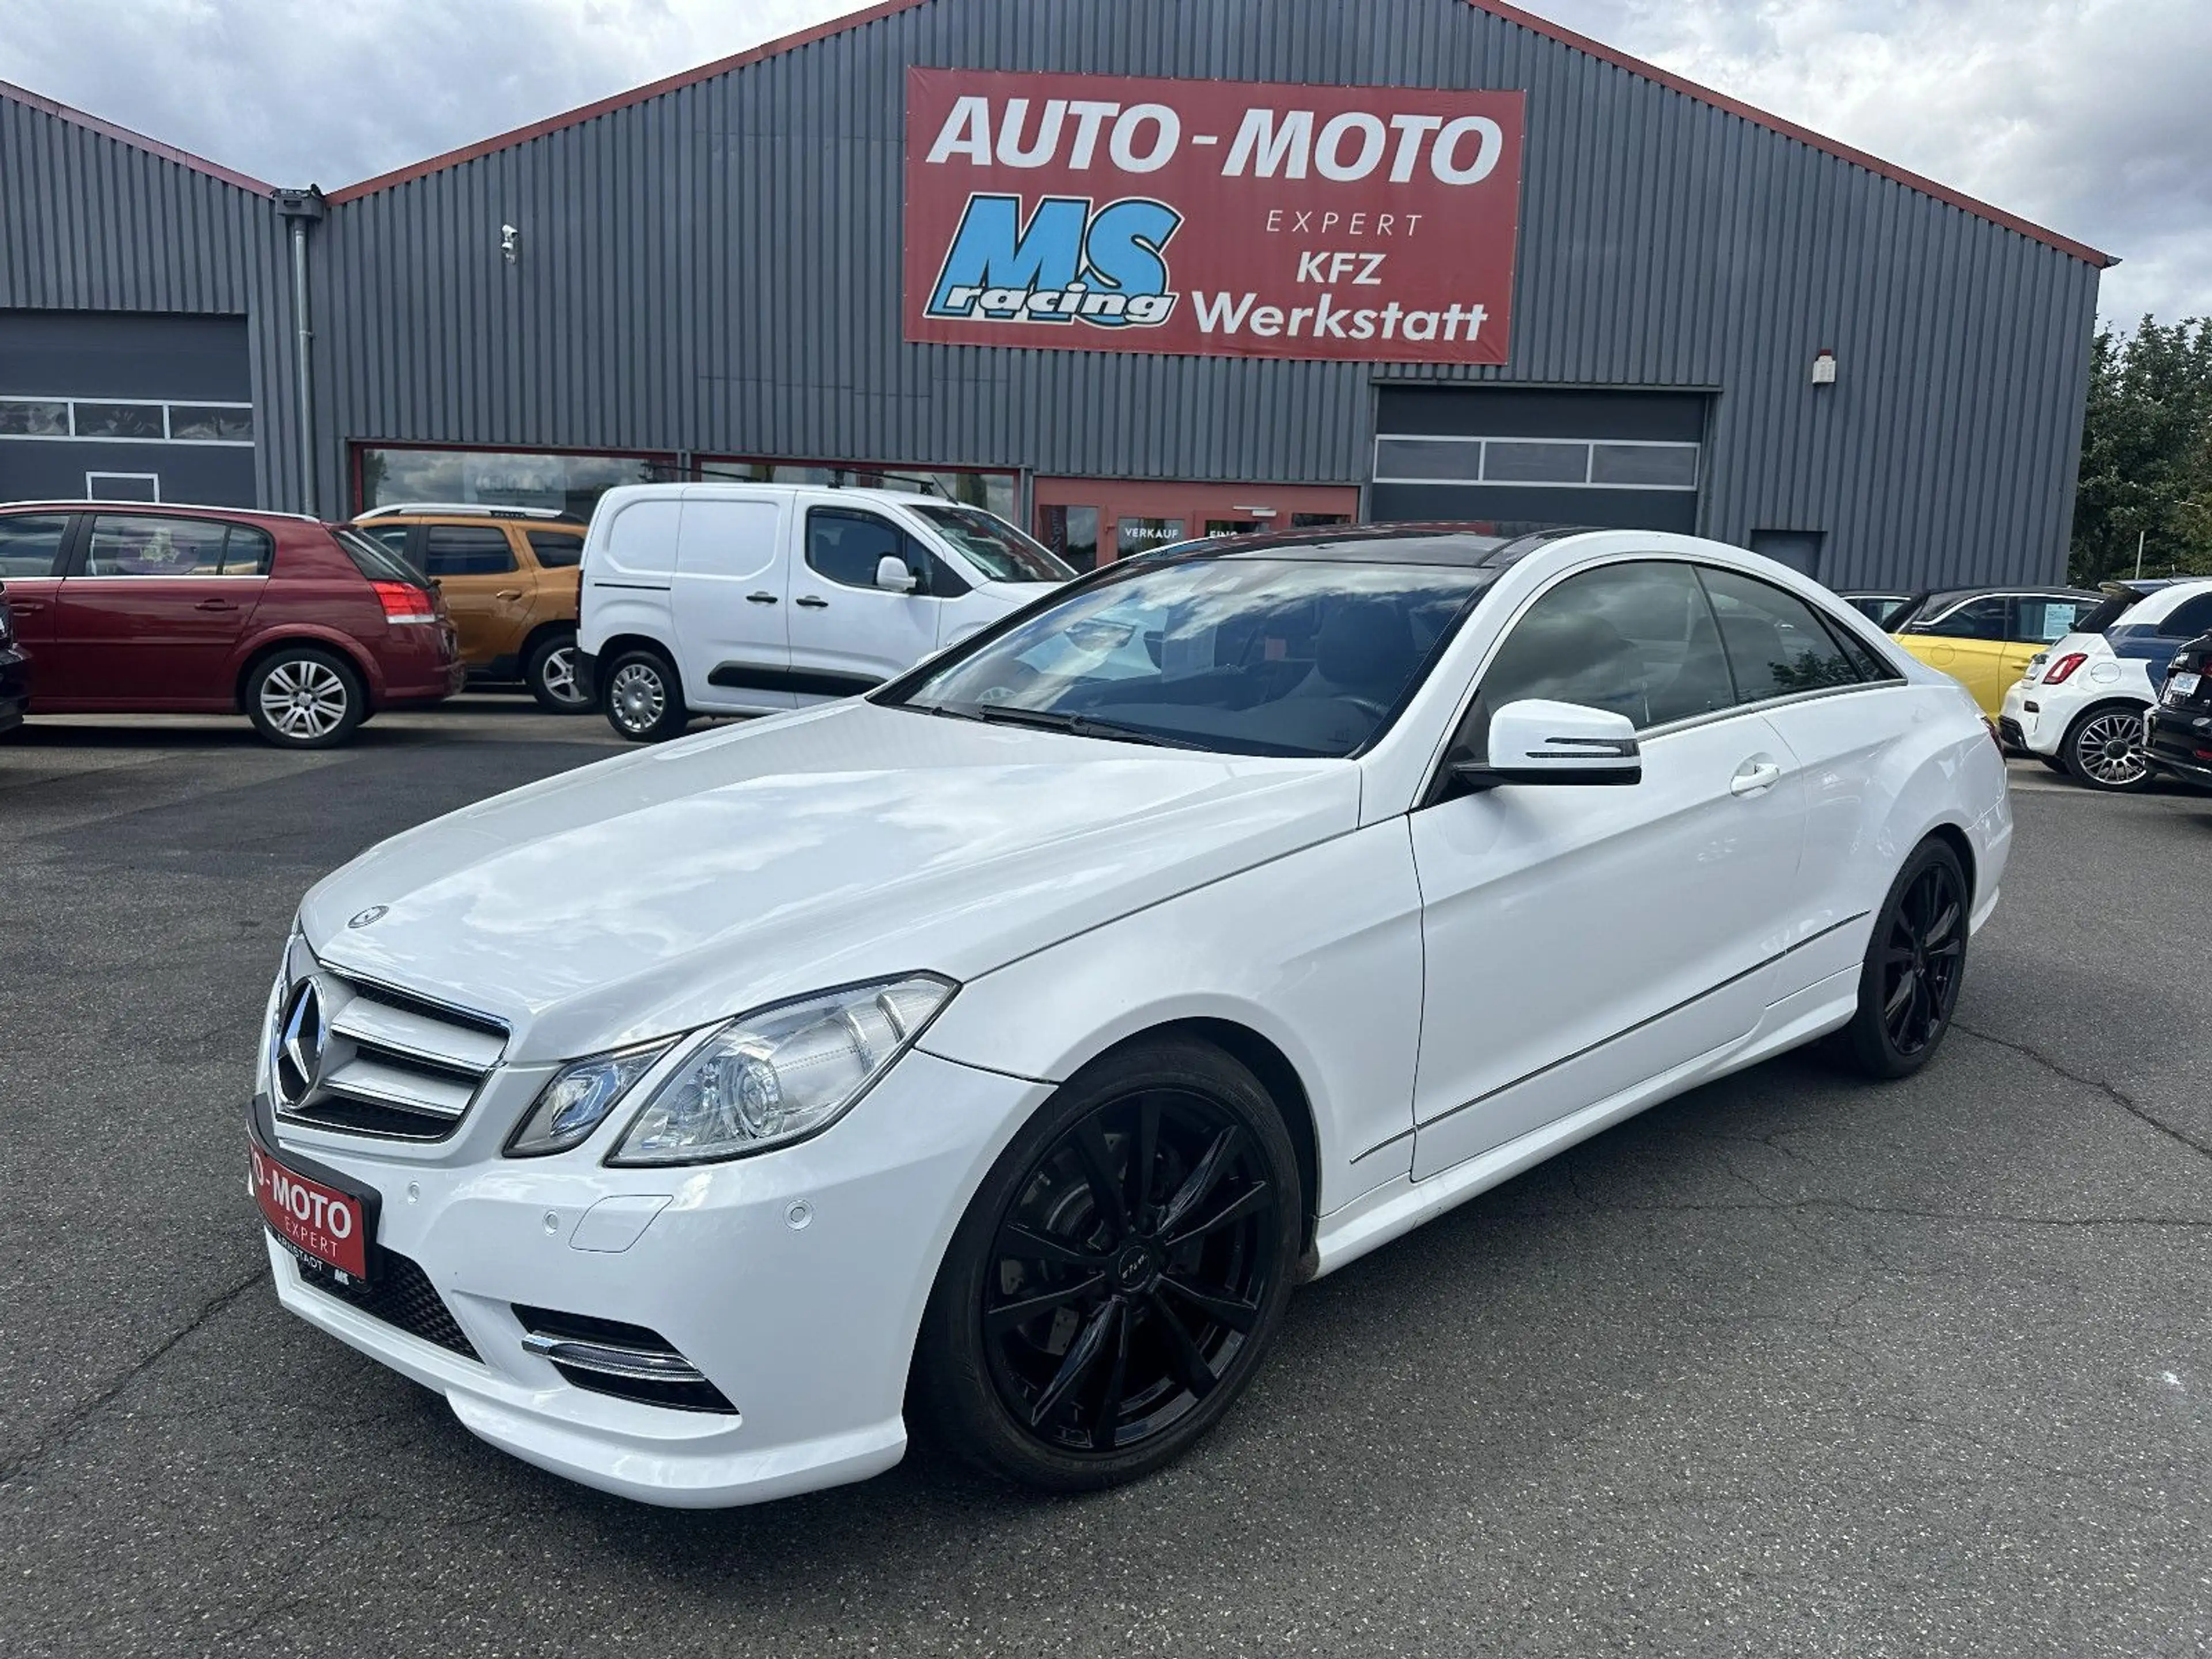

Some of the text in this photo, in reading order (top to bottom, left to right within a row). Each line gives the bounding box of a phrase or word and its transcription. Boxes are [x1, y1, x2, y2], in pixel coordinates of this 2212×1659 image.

[1266, 209, 1422, 237] EXPERT
[924, 192, 1184, 327] MS
[1296, 251, 1387, 286] KFZ
[945, 282, 1177, 321] racing
[1191, 291, 1488, 342] Werkstatt
[1124, 527, 1180, 539] VERKAUF
[284, 1216, 338, 1257] EXPERT
